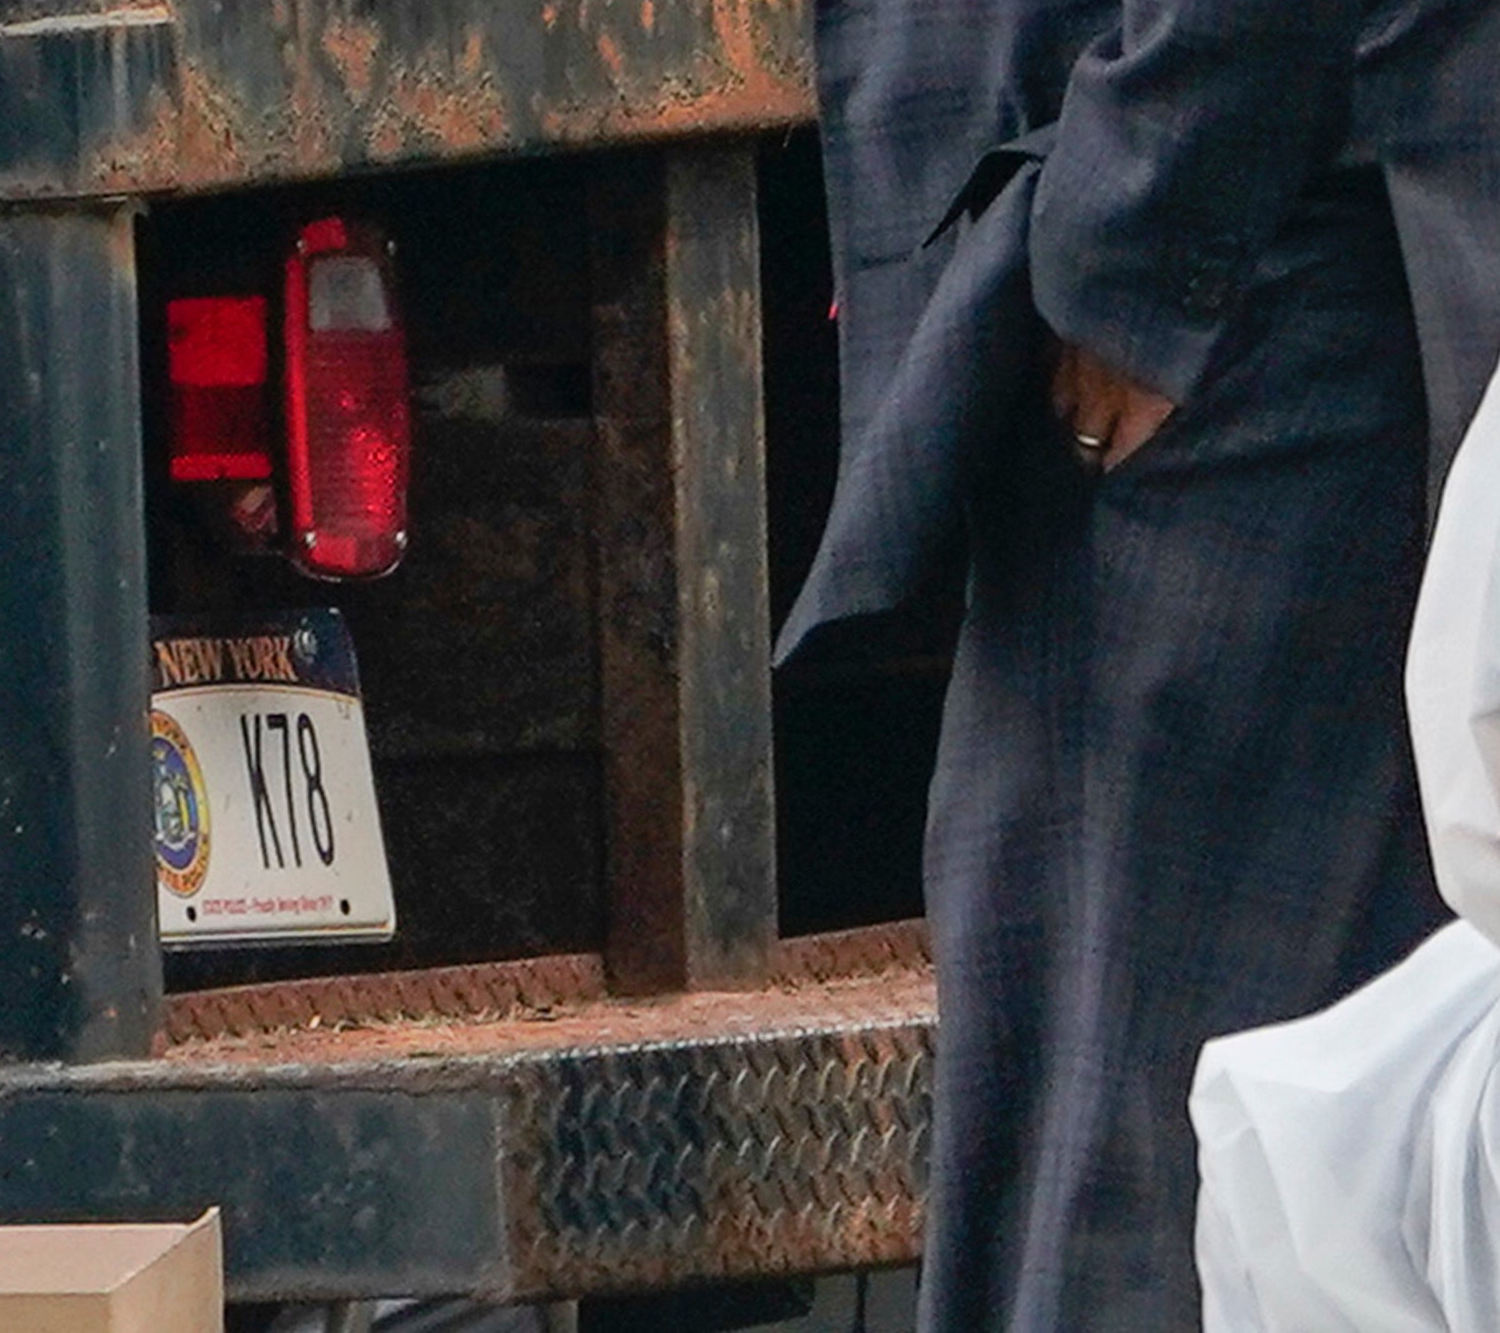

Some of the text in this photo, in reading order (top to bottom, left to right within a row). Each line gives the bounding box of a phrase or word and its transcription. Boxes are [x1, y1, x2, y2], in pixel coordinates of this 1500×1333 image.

[154, 636, 299, 686] NEW YORK
[240, 711, 335, 869] K78
